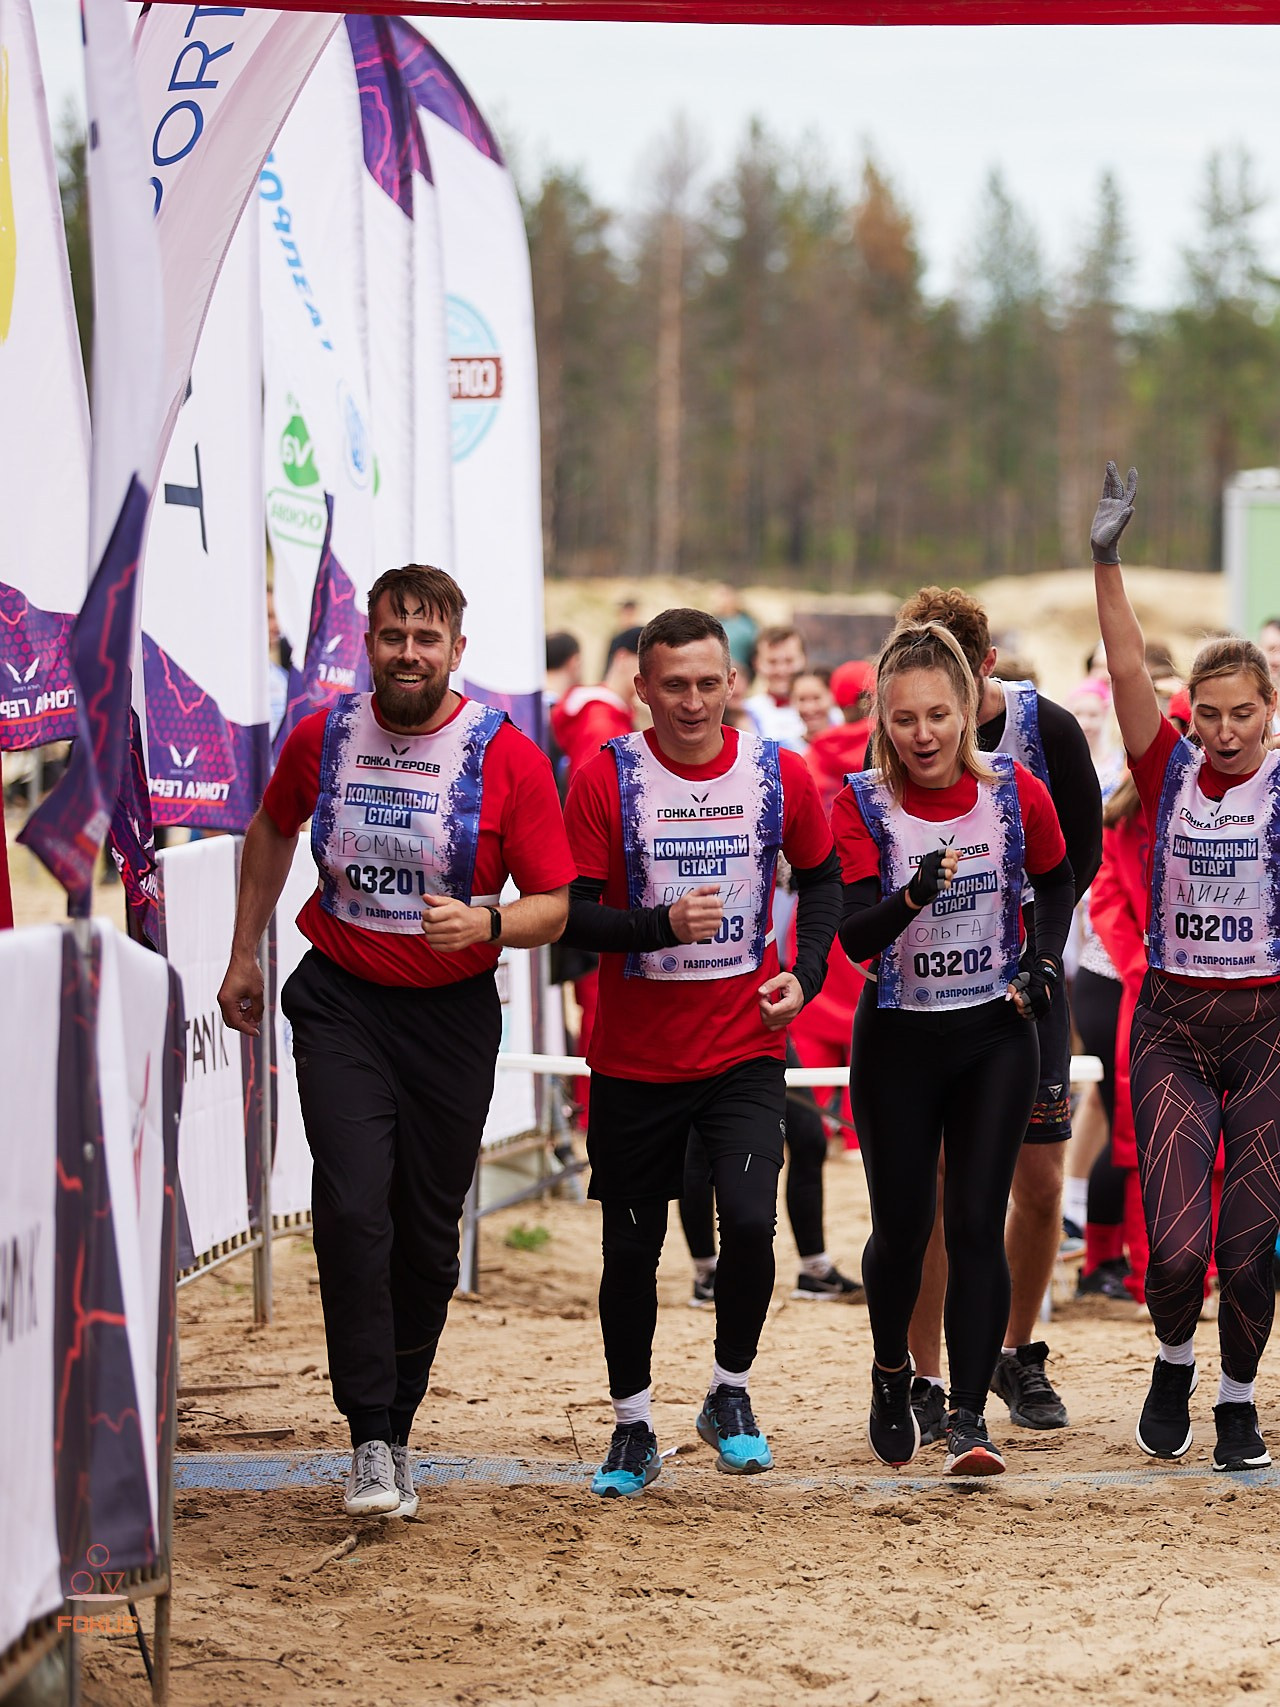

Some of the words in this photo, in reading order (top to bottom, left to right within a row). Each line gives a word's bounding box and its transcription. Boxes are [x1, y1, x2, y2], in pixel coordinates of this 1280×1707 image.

[356, 755, 390, 767] ГОНКА
[395, 760, 441, 774] ГЕРОЕВ
[347, 786, 438, 811] КОМАНДНЫЙ
[367, 807, 409, 826] СТАРТ
[657, 807, 697, 818] ГОНКА
[699, 805, 744, 817] ГЕРОЕВ
[1179, 807, 1211, 829] ГОНКА
[1214, 814, 1255, 828] ГЕРОЕВ
[341, 831, 424, 860] РОМАН
[655, 834, 748, 859] КОМАНДНЫЙ
[1174, 838, 1258, 859] КОМАНДНЫЙ
[681, 858, 723, 875] СТАРТ
[1191, 860, 1233, 875] СТАРТ
[345, 864, 425, 895] 03201
[934, 895, 973, 915] СТАРТ
[1175, 912, 1253, 942] 03208
[683, 955, 743, 969] ГАЗПРОМБАНК
[914, 946, 993, 978] 03202
[1193, 954, 1256, 966] ГАЗПРОМБАНК
[935, 983, 995, 999] ГАЗПРОМБАНК
